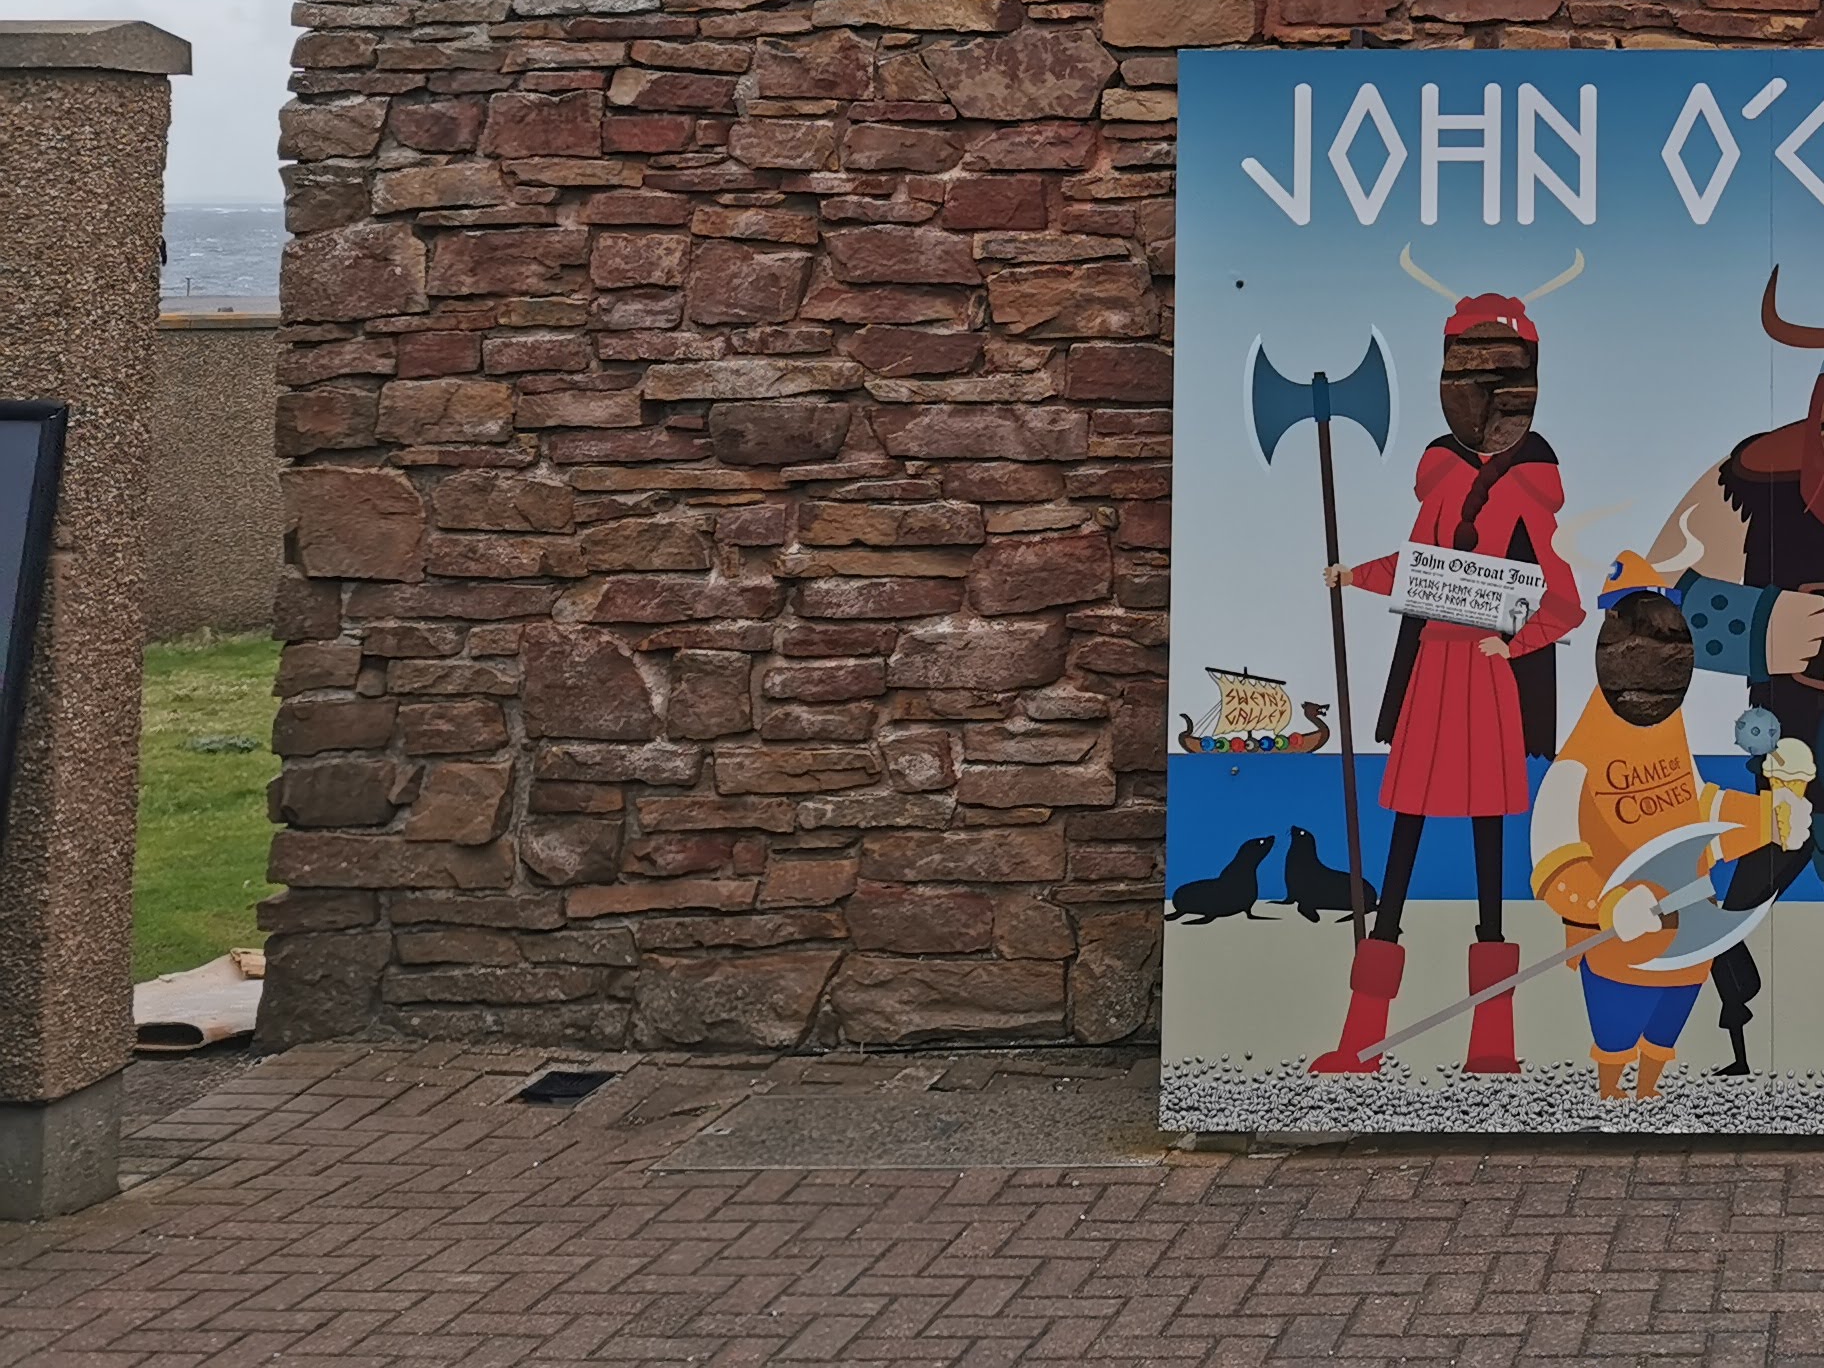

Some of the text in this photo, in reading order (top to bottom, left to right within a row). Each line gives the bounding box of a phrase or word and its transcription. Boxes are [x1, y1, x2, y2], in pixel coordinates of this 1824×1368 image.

[1241, 82, 1597, 226] JOHN
[1410, 550, 1446, 570] John
[1449, 558, 1505, 581] O'Groat
[1409, 576, 1440, 591] VIKING
[1407, 587, 1501, 613] ESCAPES FROM CASTLE
[1225, 688, 1287, 708] SWEYN'S
[1225, 707, 1287, 726] GALLEY
[1606, 759, 1671, 790] GAME
[1614, 782, 1692, 824] CONES
